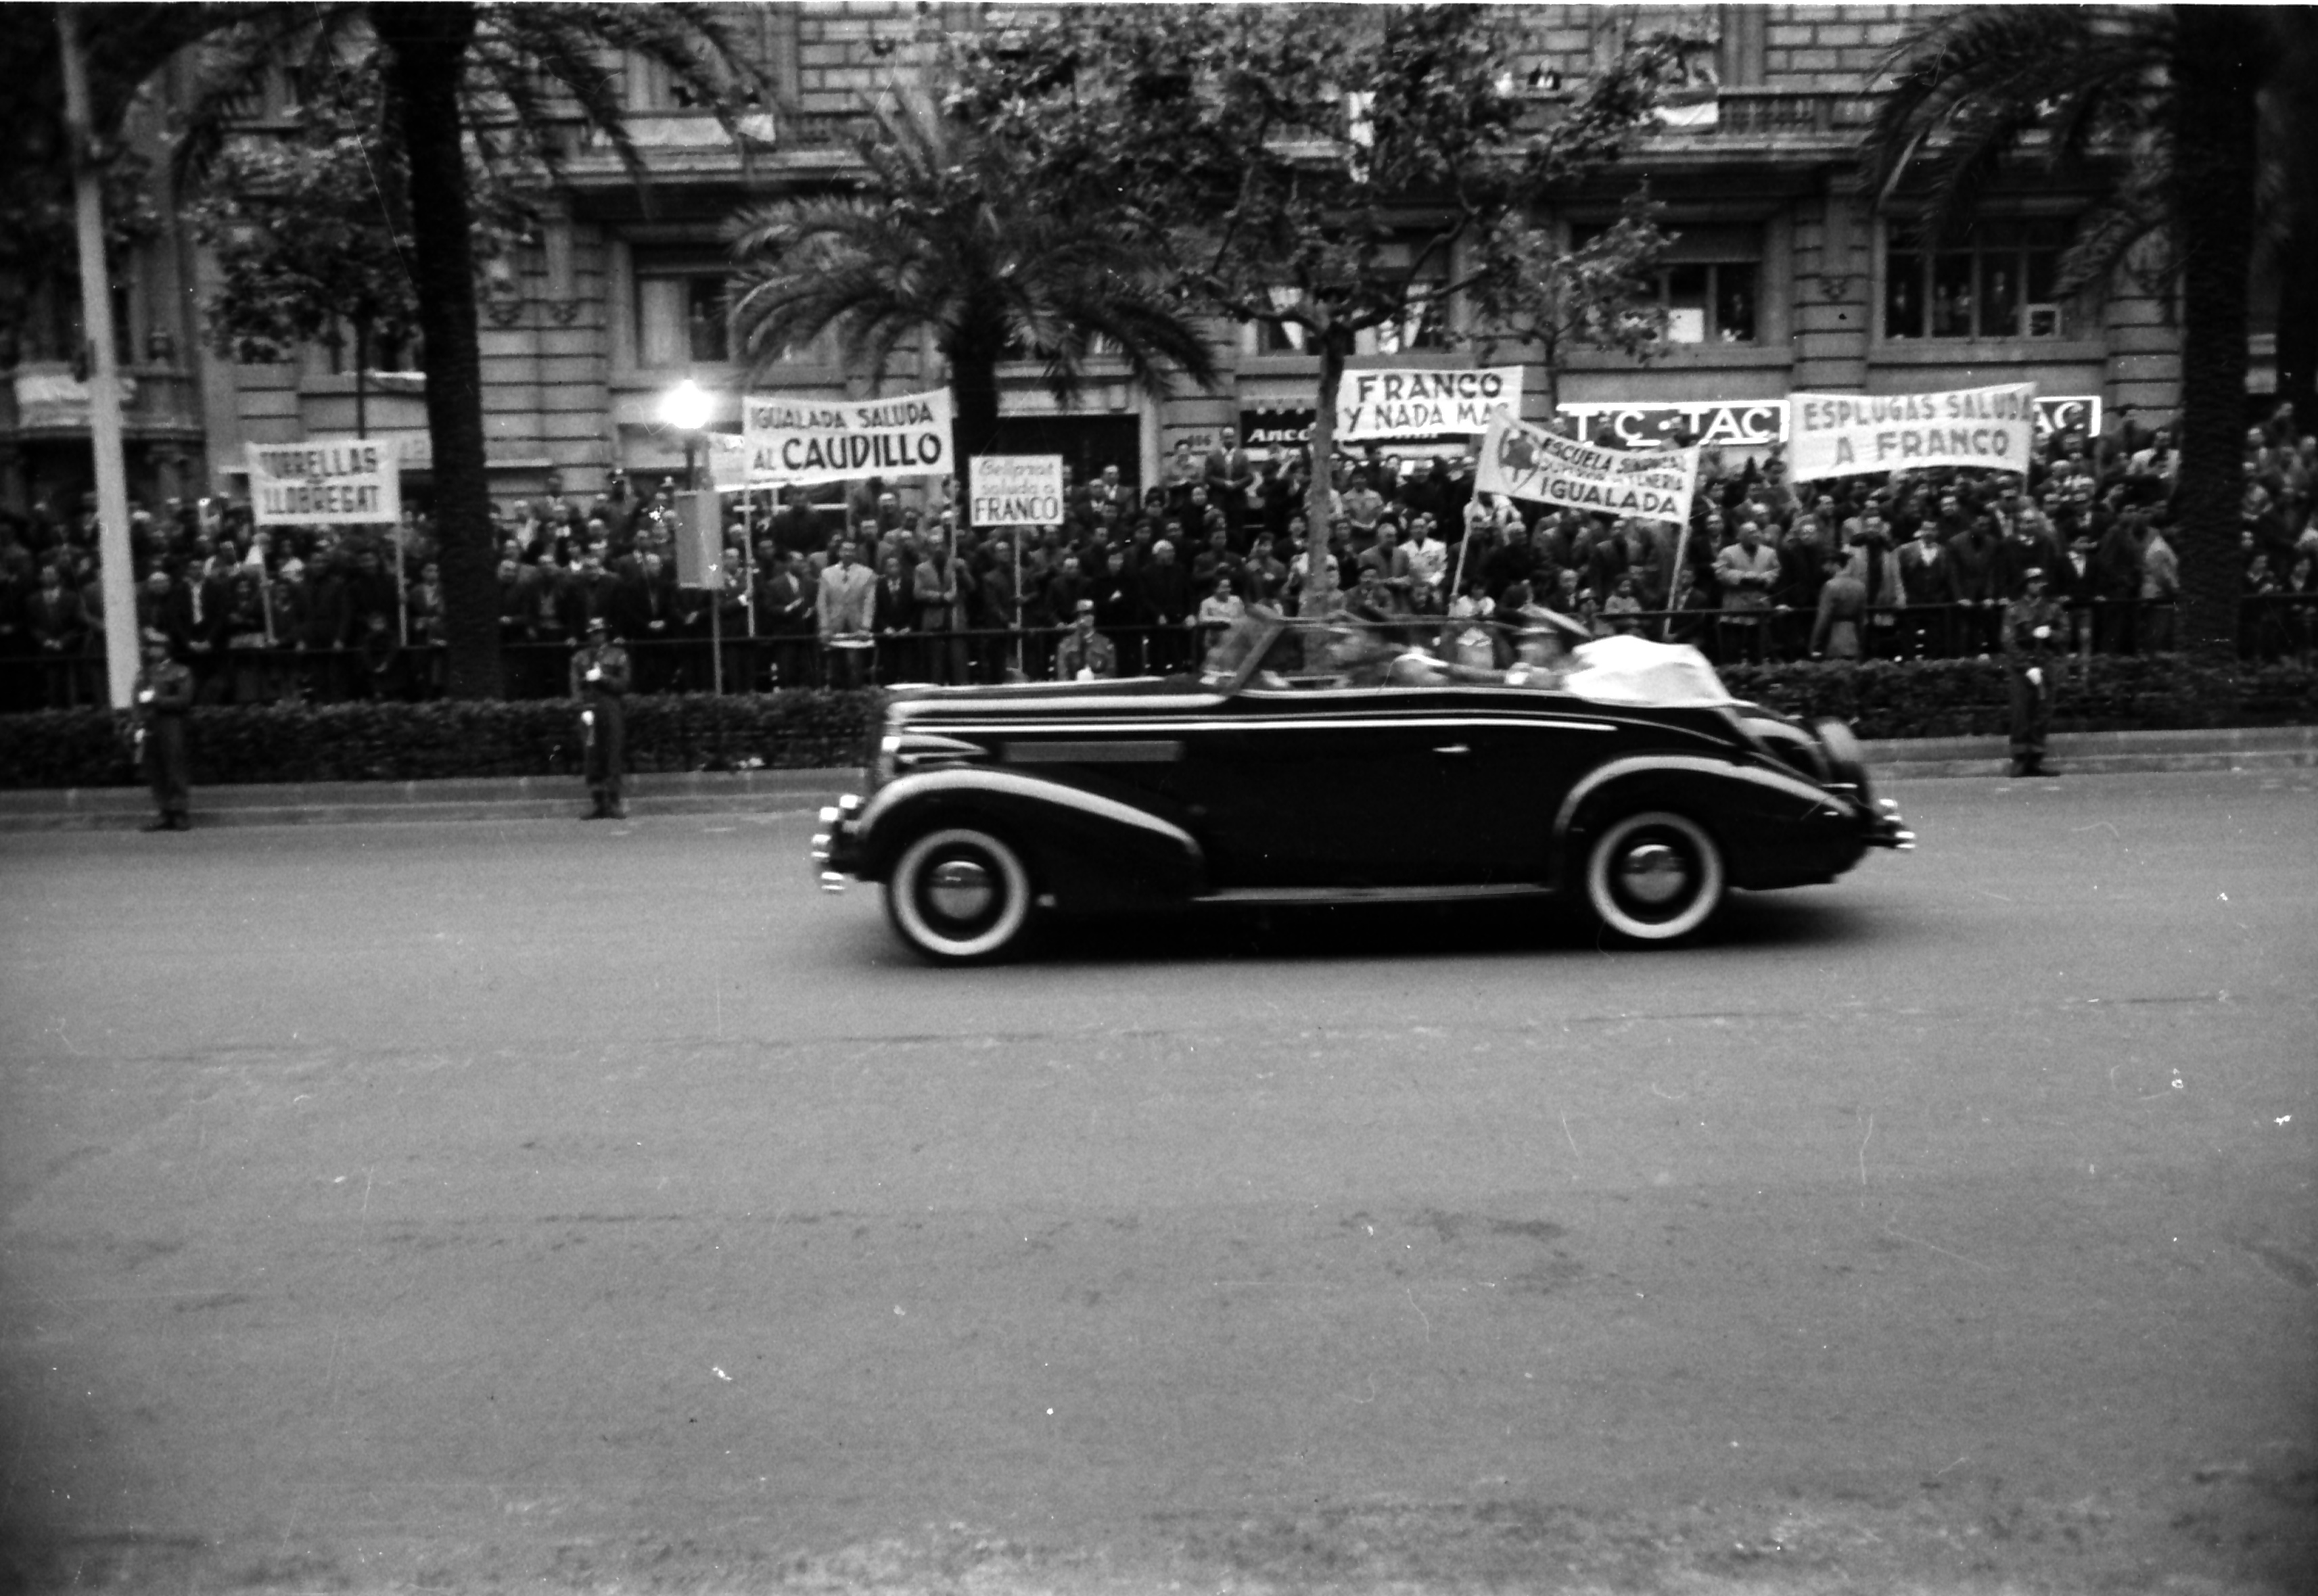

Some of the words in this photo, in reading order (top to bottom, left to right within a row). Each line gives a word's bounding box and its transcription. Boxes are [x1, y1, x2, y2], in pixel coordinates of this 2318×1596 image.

[1358, 373, 1502, 404] FRANCO
[751, 406, 847, 429] IGUALADA
[856, 402, 934, 429] SALUDA
[1344, 406, 1362, 433] Y
[1375, 404, 1445, 431] NADA
[1457, 402, 1509, 426] MA
[1805, 394, 1934, 431] ESPLUGAS
[754, 448, 776, 471] AL
[782, 432, 942, 471] CAUDILLO
[1542, 437, 1614, 472] ESCUELA
[1836, 436, 1855, 465] A
[1877, 429, 2010, 461] FRANCO
[974, 496, 1059, 521] FRANCO
[1540, 476, 1677, 513] IGUALADA
